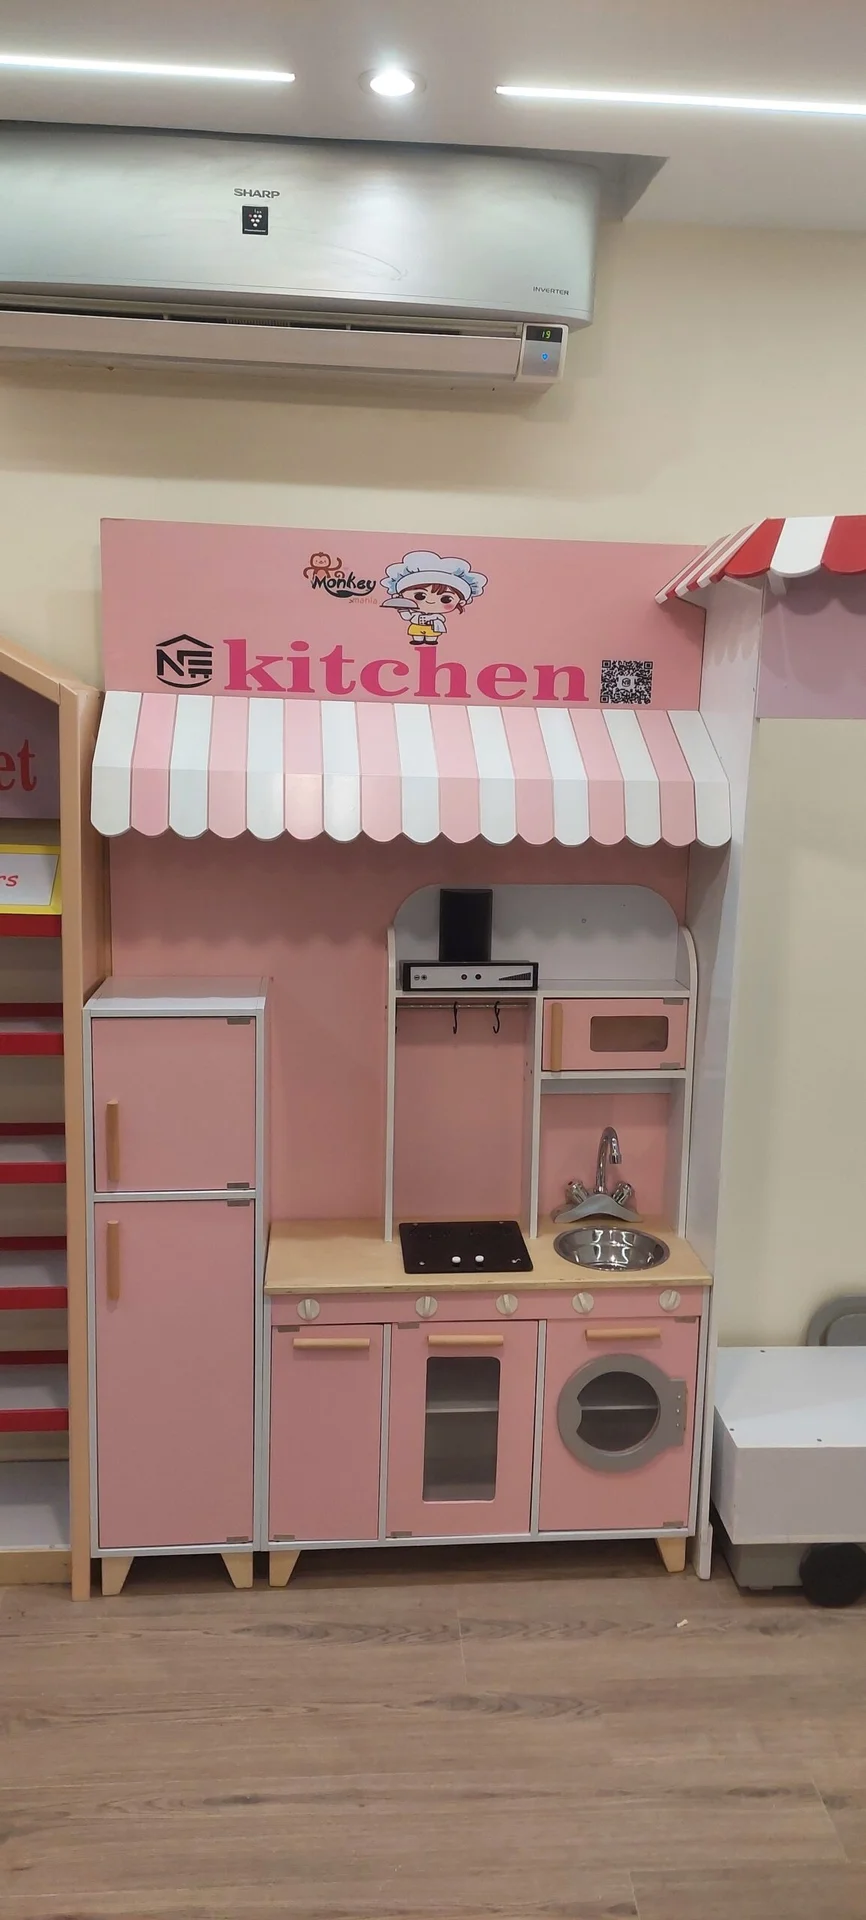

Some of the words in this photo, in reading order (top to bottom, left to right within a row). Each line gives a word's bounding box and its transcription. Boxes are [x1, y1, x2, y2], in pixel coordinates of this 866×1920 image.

[233, 188, 280, 198] SHARP
[532, 286, 570, 296] INVERTER
[541, 330, 551, 339] 19
[311, 571, 377, 597] Monkey
[223, 639, 589, 702] kitchen
